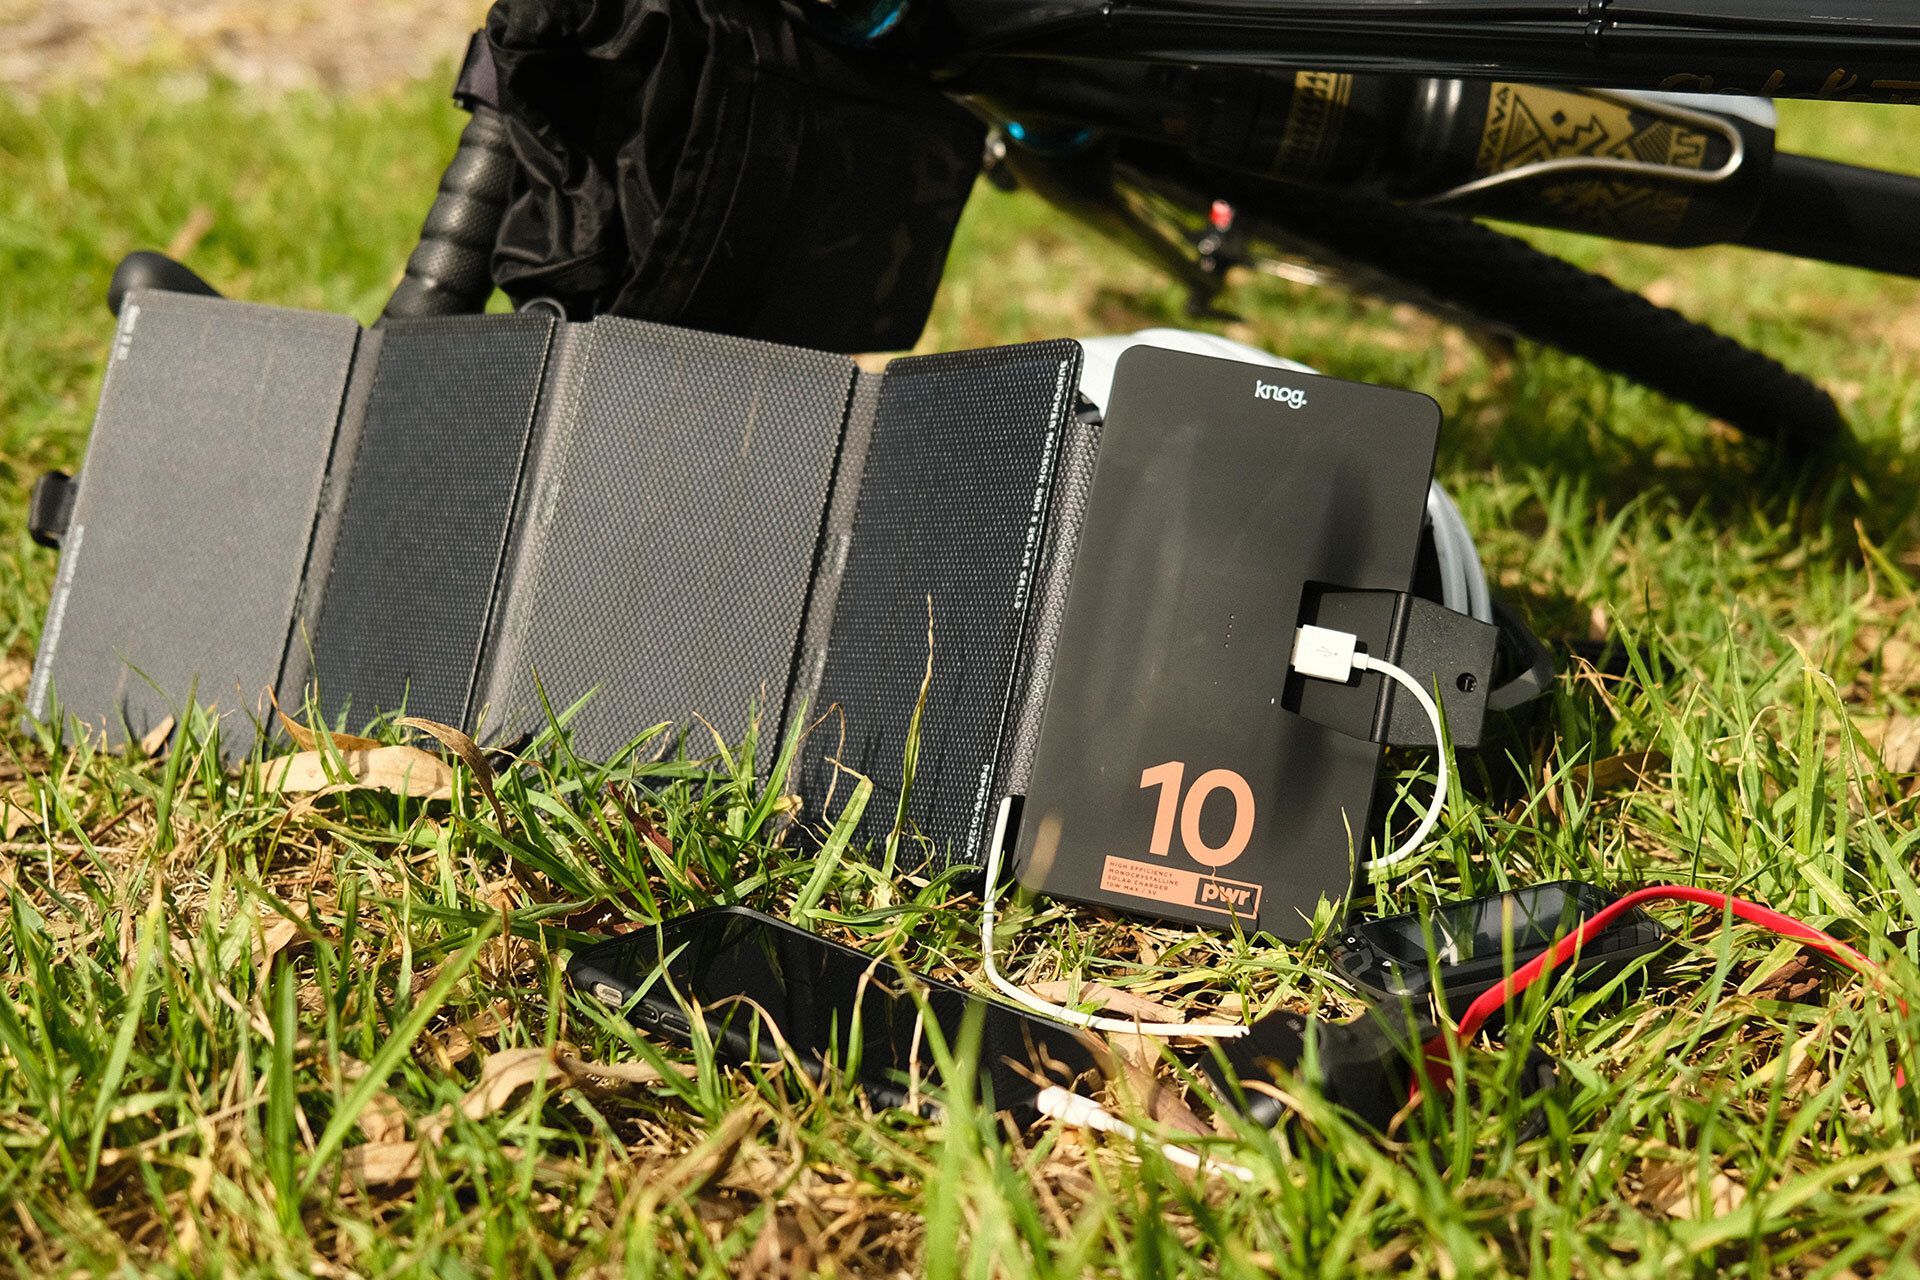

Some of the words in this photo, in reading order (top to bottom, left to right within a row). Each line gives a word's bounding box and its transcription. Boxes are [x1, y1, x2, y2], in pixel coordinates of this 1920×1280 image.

[1048, 360, 1069, 430] SUNPOWER
[1021, 526, 1036, 568] SOLAR
[1014, 570, 1028, 609] CELLS
[1140, 760, 1256, 867] 10
[1108, 868, 1179, 886] MONOCRYSTALLINE
[1109, 861, 1128, 869] HIGH
[1130, 865, 1173, 878] EFFICIENCY
[1107, 875, 1131, 884] SOLAR
[1133, 880, 1169, 891] CHARGER
[1123, 884, 1139, 892] MAX
[1201, 882, 1251, 906] pwr
